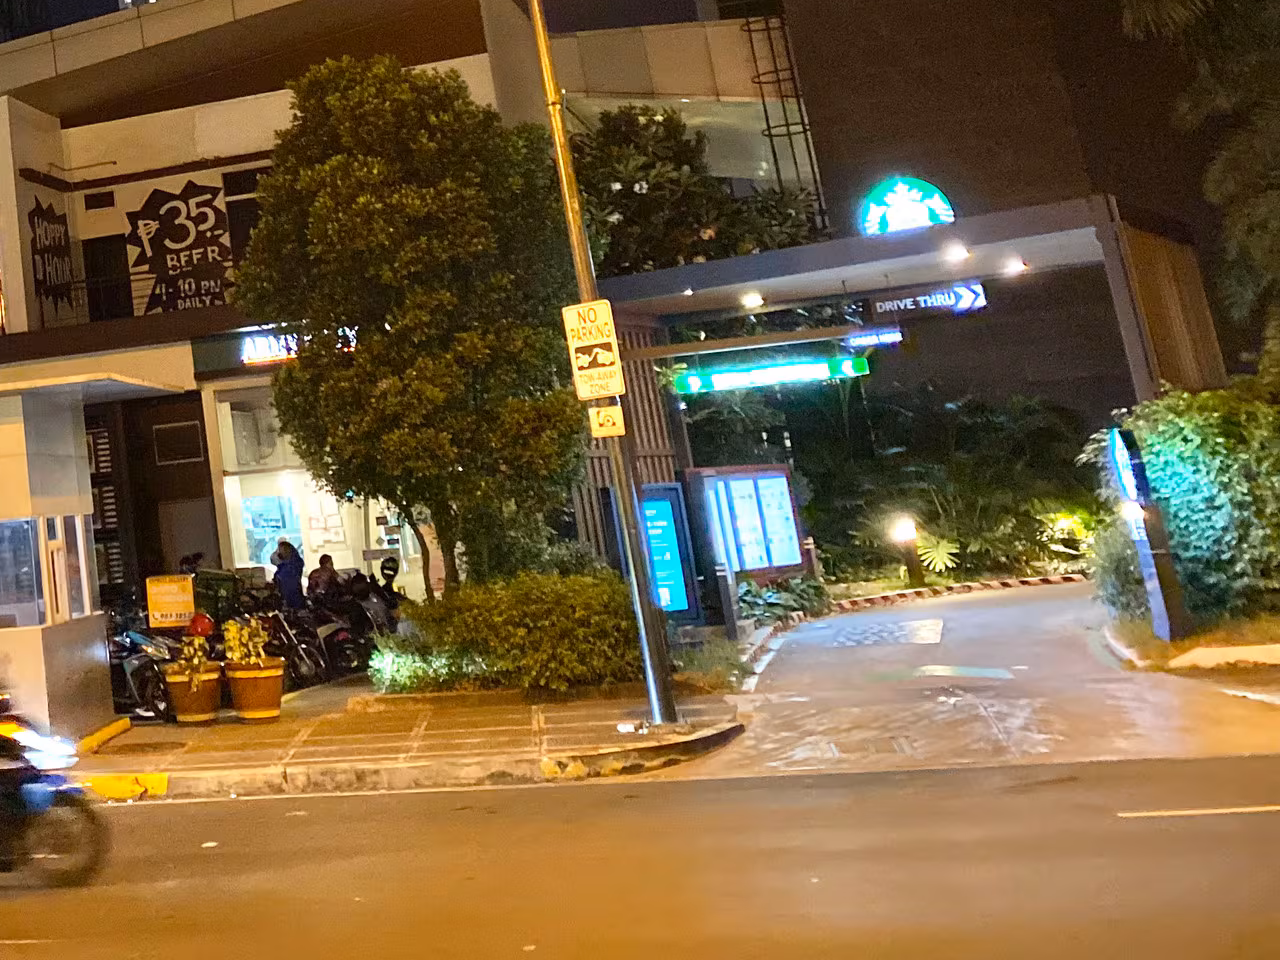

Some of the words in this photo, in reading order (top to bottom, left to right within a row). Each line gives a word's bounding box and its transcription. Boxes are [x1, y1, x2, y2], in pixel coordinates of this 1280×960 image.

[177, 295, 213, 310] DAILY
[876, 298, 916, 313] DRIVE
[916, 291, 957, 308] THRU
[577, 307, 598, 325] NO
[570, 322, 612, 342] PARKING
[578, 371, 618, 384] TOW-AWAY
[589, 383, 612, 394] ZONE
